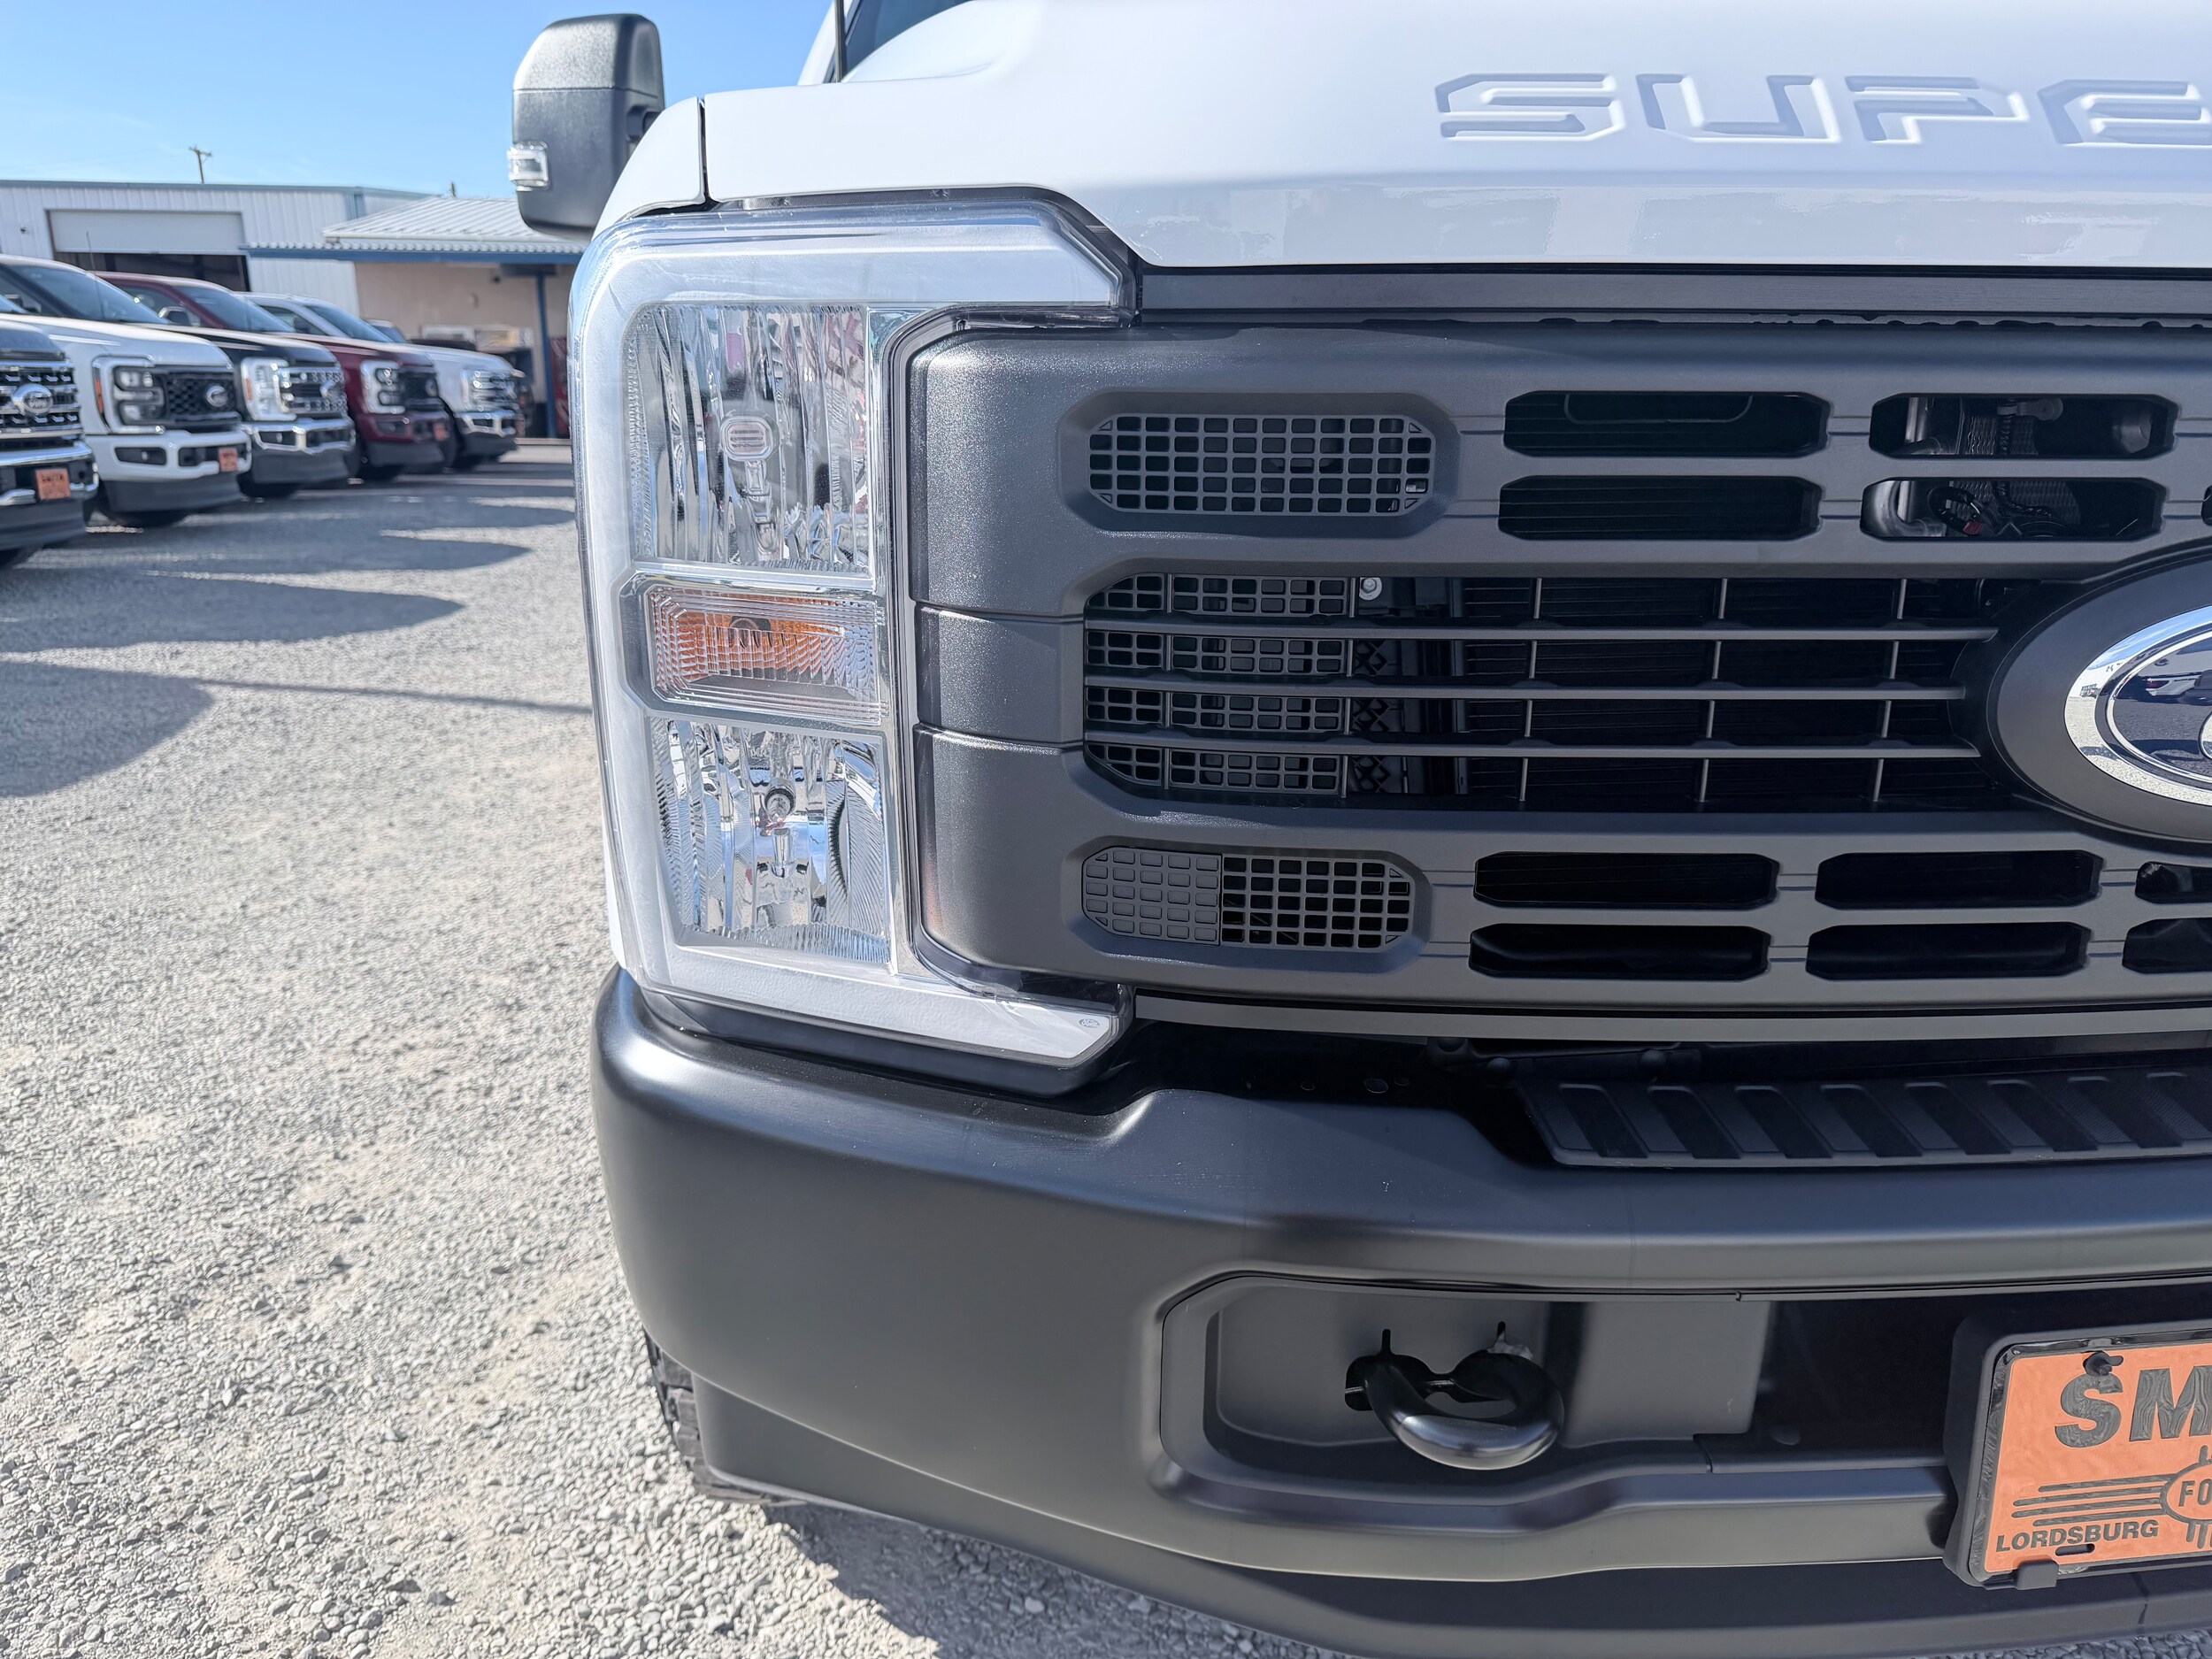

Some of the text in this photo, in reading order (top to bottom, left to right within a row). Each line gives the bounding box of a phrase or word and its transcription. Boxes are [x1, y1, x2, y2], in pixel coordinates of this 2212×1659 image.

[1435, 73, 2212, 148] SUPE
[2055, 1365, 2212, 1448] SM
[2178, 1479, 2212, 1508] FO
[1996, 1519, 2159, 1553] LORDSBURG
